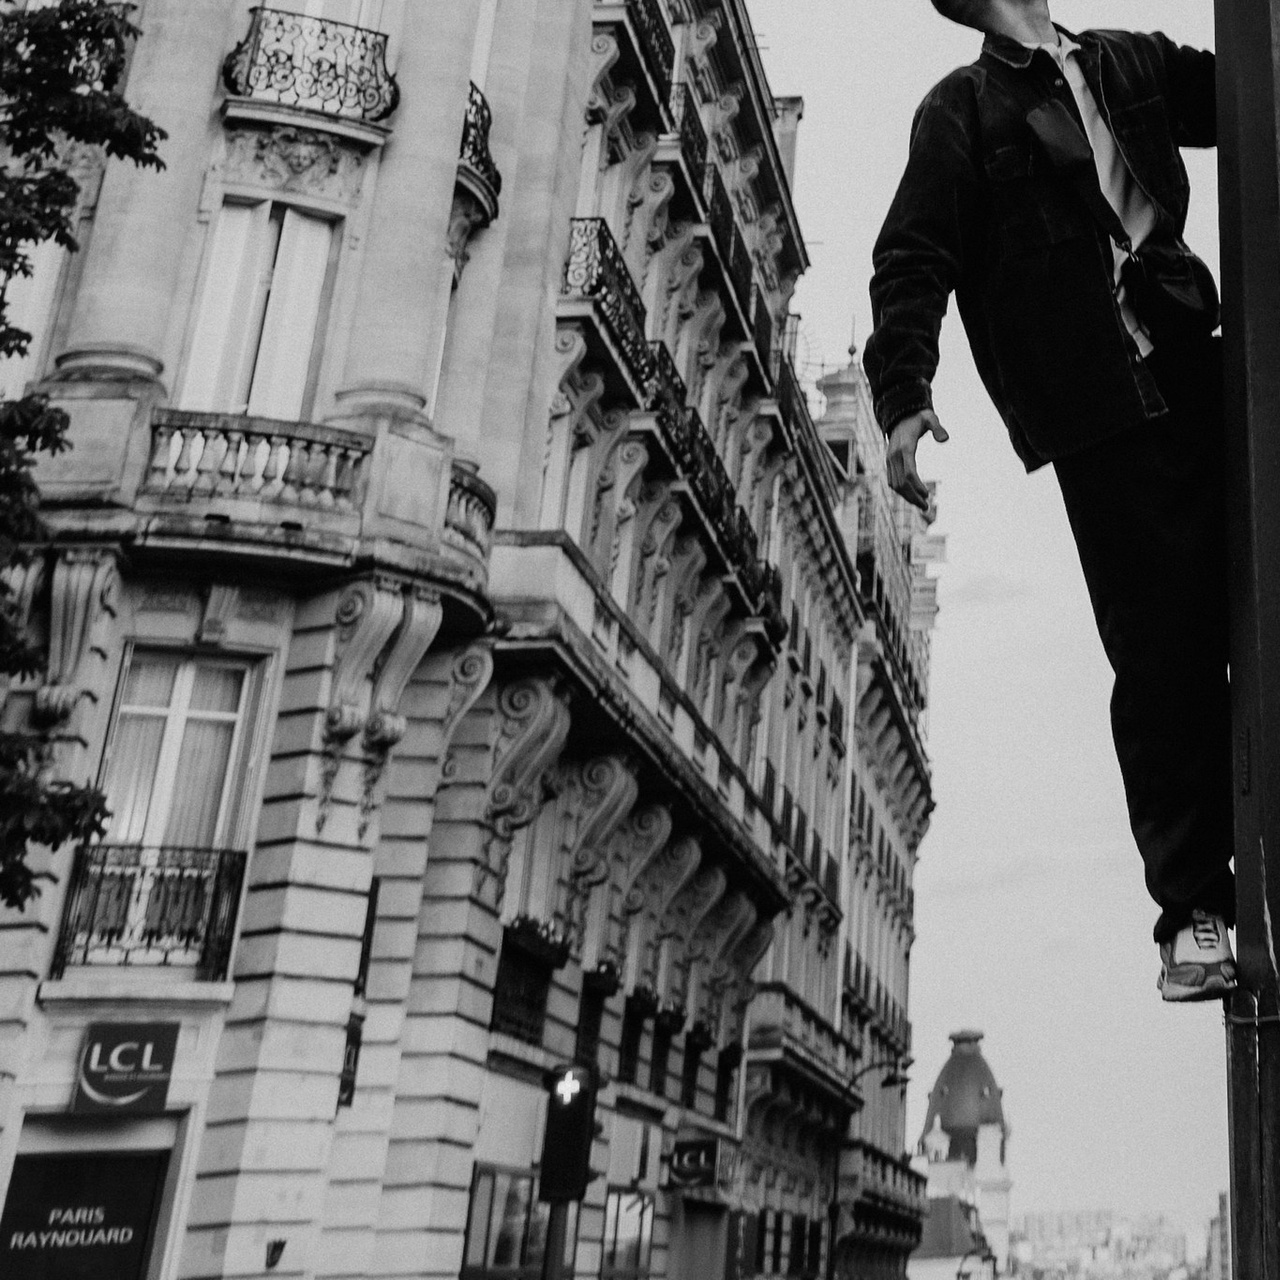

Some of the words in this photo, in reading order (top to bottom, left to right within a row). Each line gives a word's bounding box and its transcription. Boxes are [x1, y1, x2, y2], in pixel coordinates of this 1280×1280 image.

[89, 1042, 163, 1072] LCL
[48, 1206, 105, 1225] PARIS
[9, 1226, 134, 1249] RAYNOUARD
